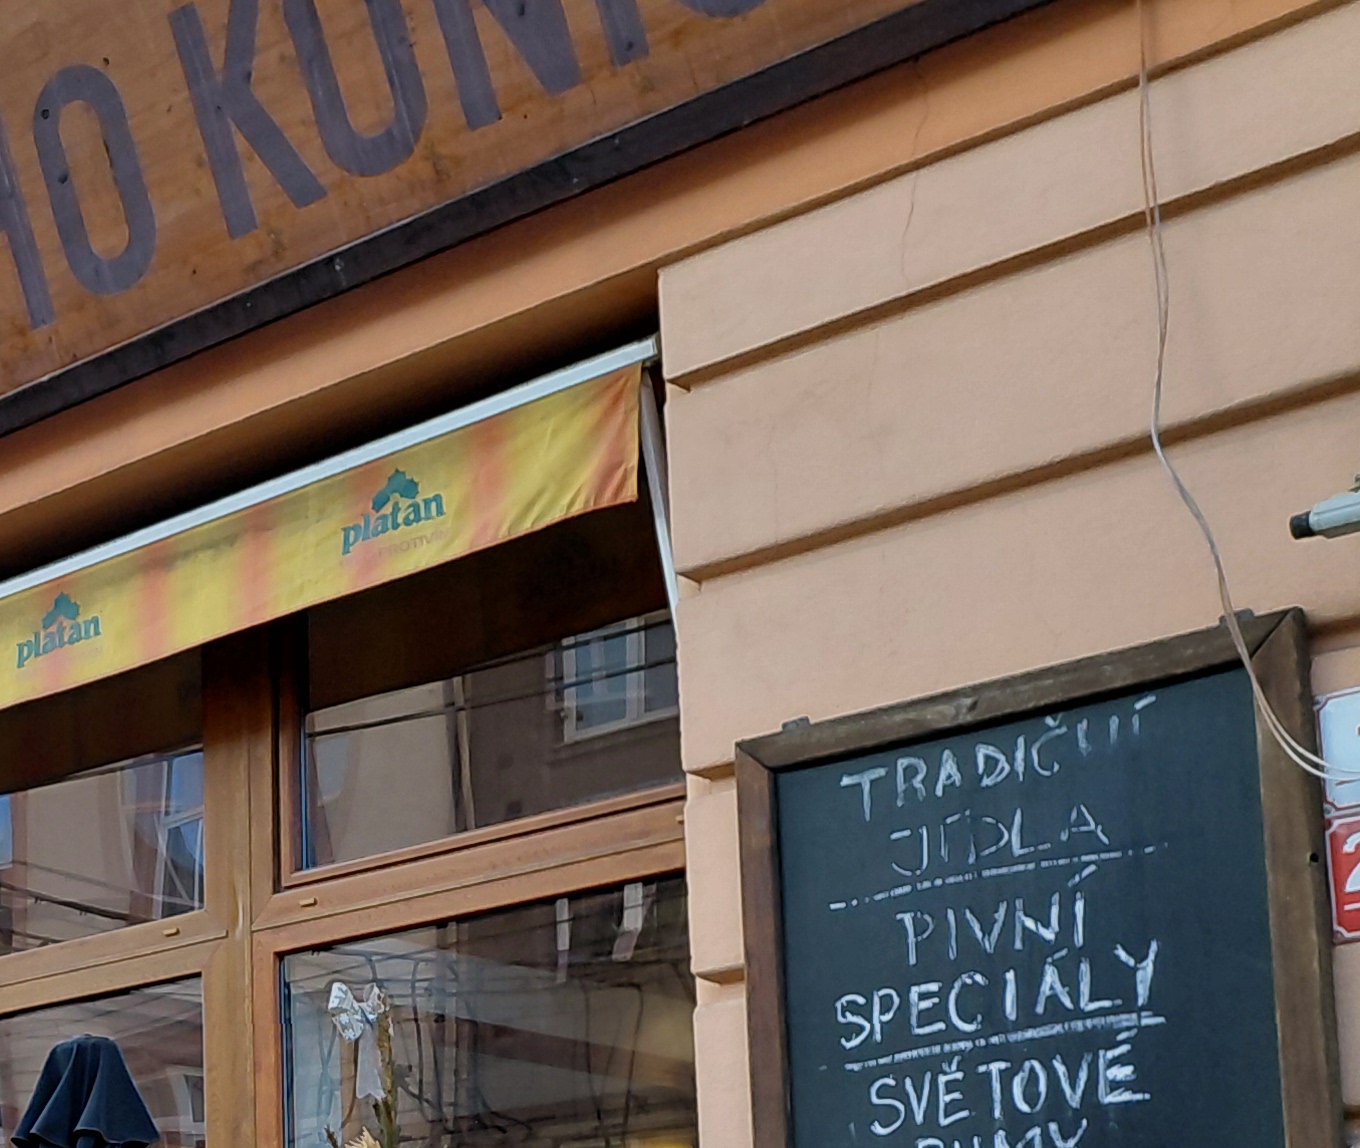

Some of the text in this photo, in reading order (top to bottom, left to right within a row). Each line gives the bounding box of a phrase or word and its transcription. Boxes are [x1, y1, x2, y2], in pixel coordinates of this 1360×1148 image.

[340, 492, 447, 556] platan
[16, 612, 103, 669] platan
[895, 866, 1099, 967] PIVNÍ
[834, 939, 1160, 1050] SPECIÁLY
[870, 1028, 1151, 1136] SVĚTOVÉ
